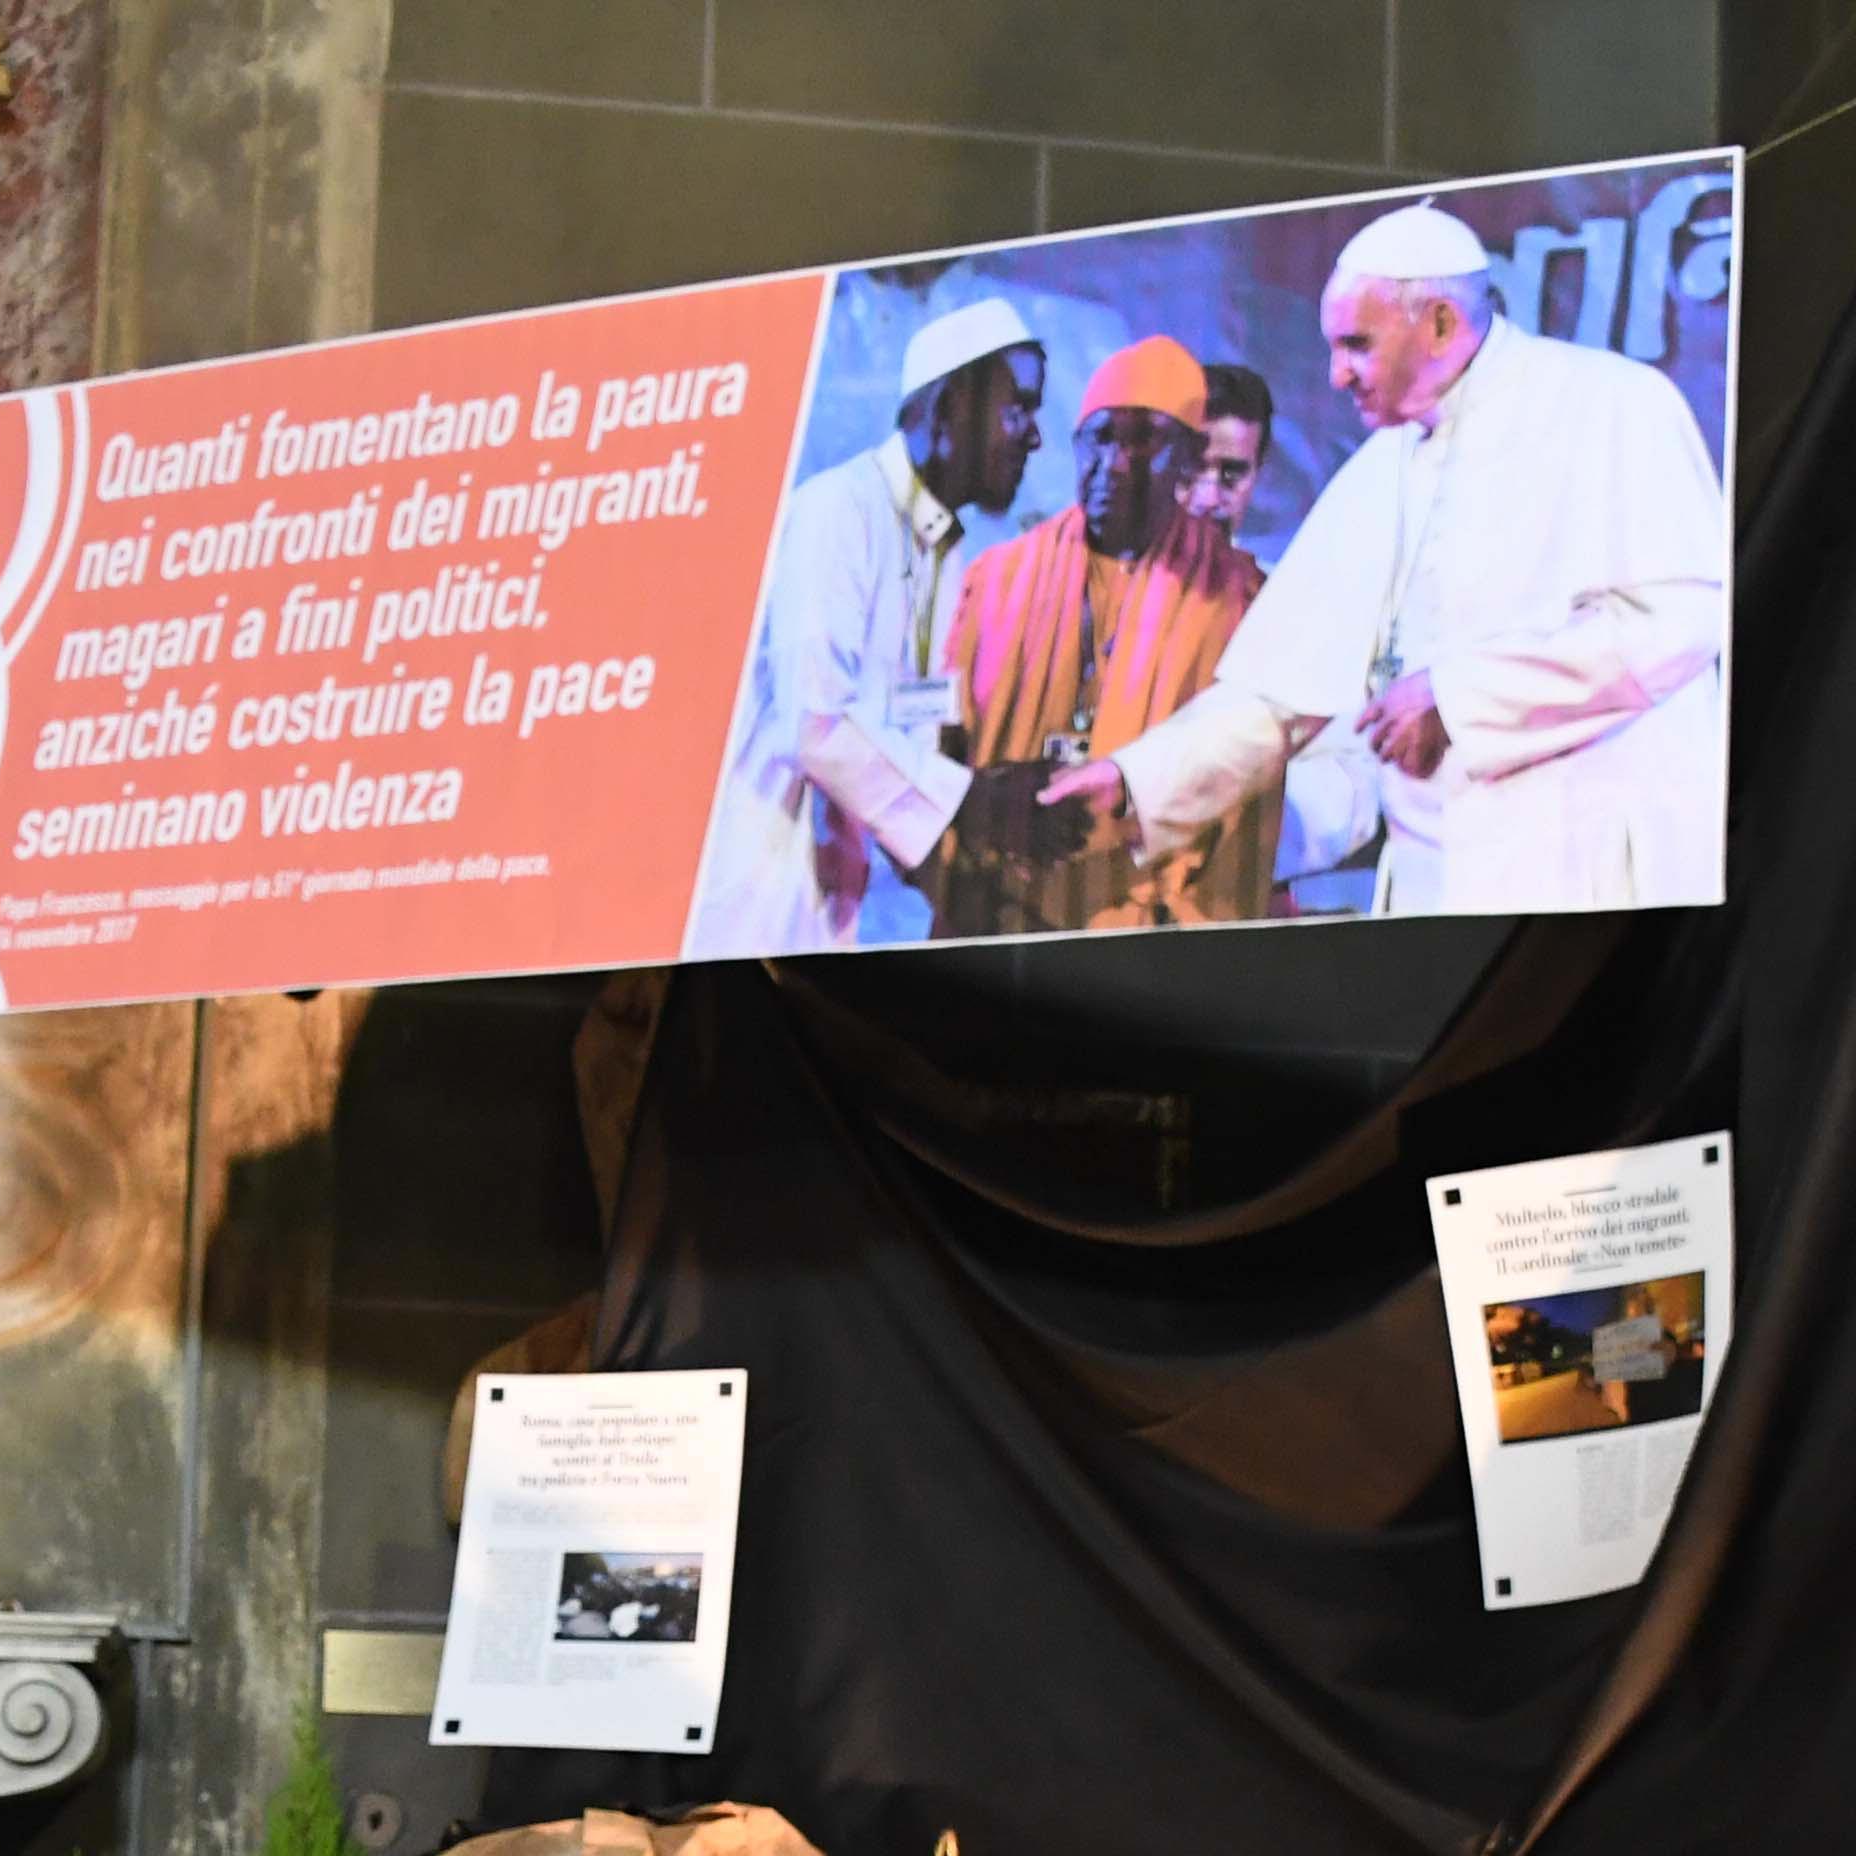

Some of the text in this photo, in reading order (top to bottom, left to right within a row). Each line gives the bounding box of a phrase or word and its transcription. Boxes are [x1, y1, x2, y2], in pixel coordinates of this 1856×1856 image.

[99, 362, 748, 500] Quanti fomentano la paura
[77, 444, 707, 590] nei confronti dei migranti,
[56, 558, 550, 689] magari a fini politici,
[35, 655, 656, 769] anziché costruire la pace
[14, 763, 463, 860] seminano violenza
[1486, 1234, 1538, 1255] contro
[1601, 1218, 1624, 1237] dei
[1571, 1198, 1621, 1219] blocco
